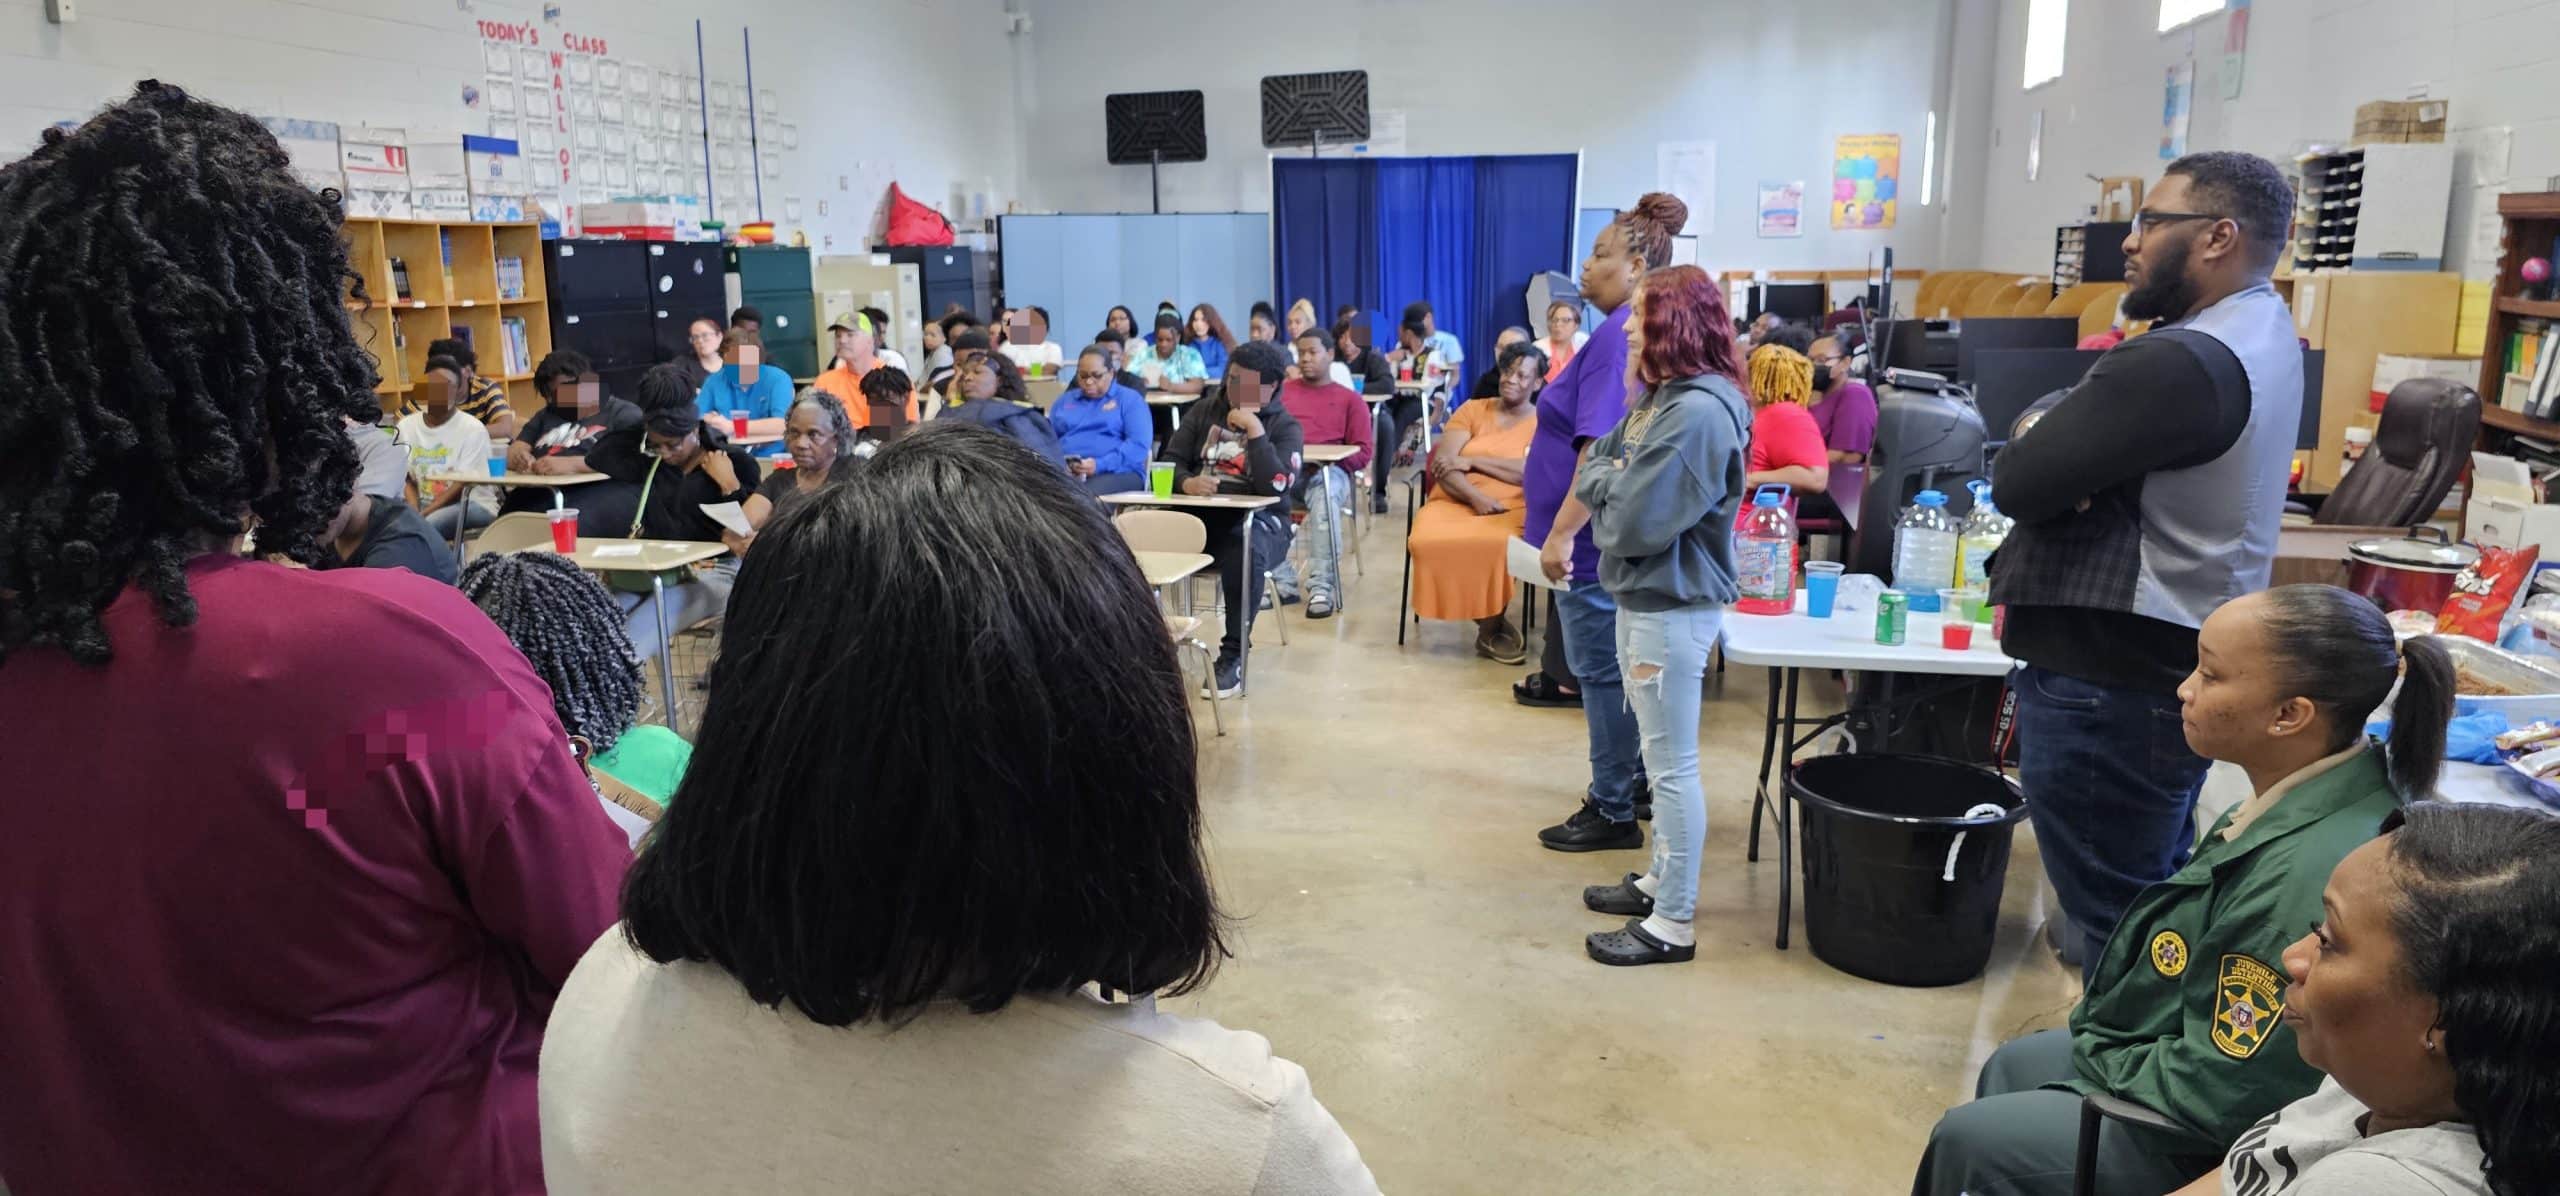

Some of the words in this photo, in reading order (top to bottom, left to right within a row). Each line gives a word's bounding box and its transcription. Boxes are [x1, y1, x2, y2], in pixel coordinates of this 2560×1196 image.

[477, 20, 538, 45] TODAY'S
[563, 32, 607, 55] CLASS
[550, 51, 567, 133] WALL
[560, 148, 570, 184] OF
[566, 206, 575, 237] FA
[2002, 690, 2016, 715] EOS
[2231, 966, 2280, 995] DETENTION
[2235, 958, 2277, 983] JUVENILE
